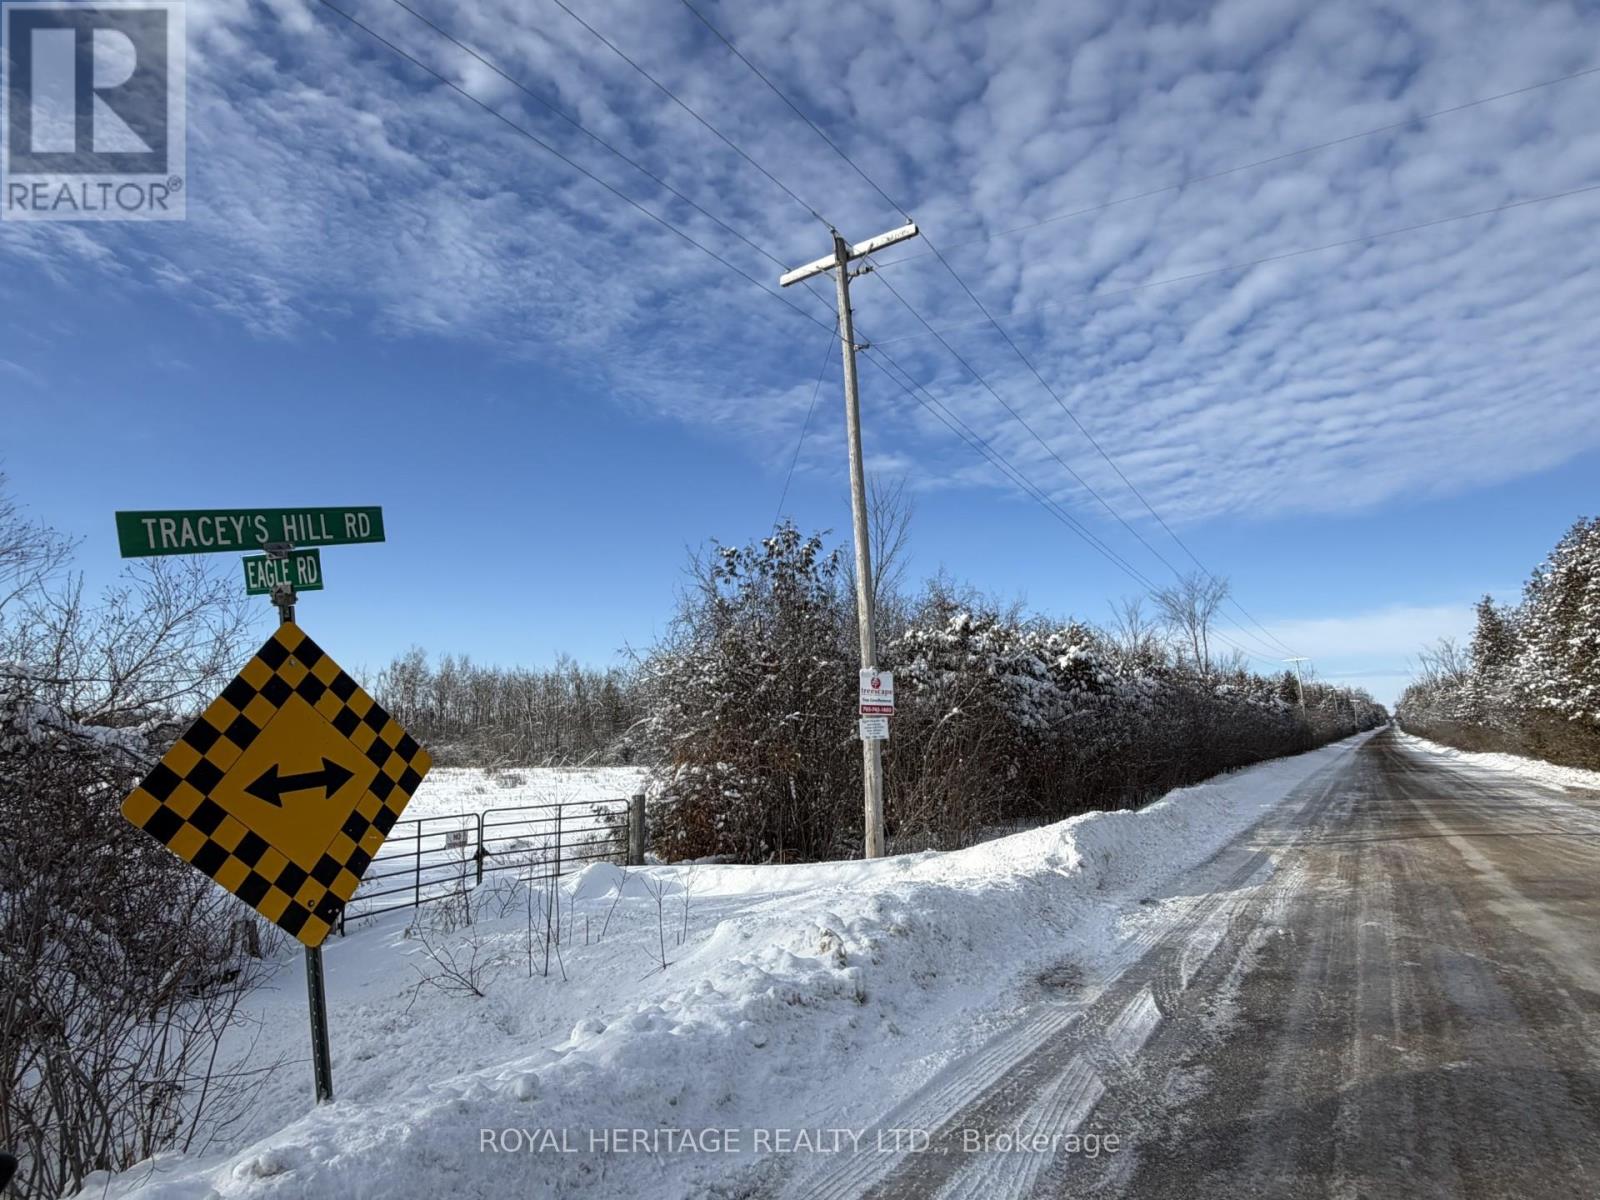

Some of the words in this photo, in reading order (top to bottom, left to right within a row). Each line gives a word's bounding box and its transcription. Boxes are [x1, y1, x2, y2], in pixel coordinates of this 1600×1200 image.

[142, 515, 269, 549] TRACEY'S
[282, 513, 334, 542] HILL
[344, 512, 371, 538] RD
[247, 558, 293, 589] EAGLE
[296, 555, 318, 585] RD
